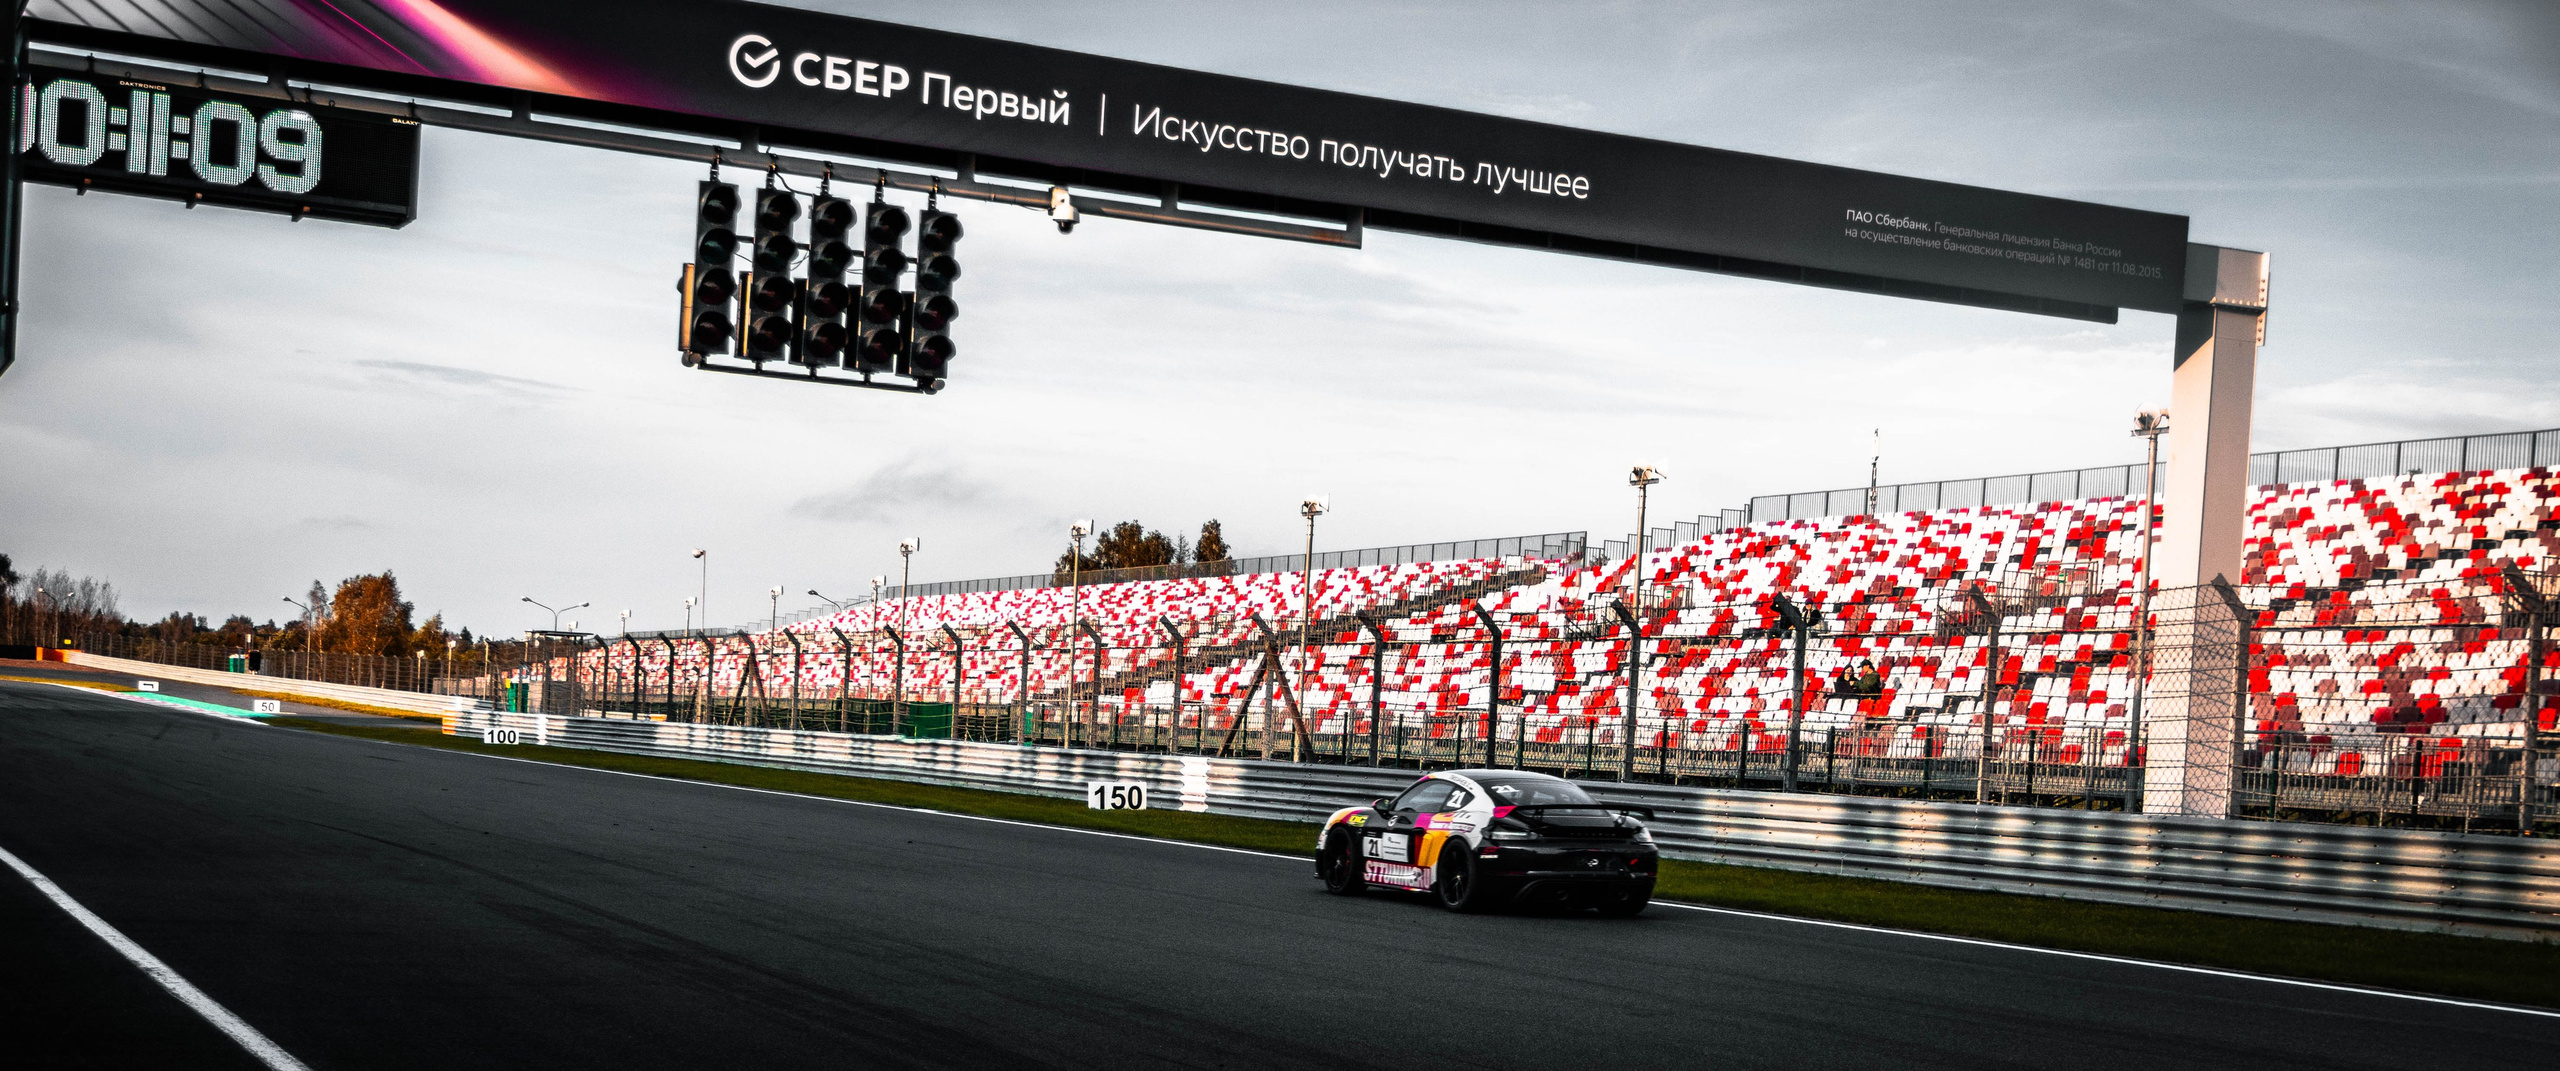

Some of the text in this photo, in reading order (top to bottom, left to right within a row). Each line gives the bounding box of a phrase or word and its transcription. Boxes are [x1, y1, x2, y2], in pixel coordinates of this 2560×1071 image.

[119, 79, 166, 91] DAKTRONICS
[792, 51, 1071, 126] СБЕР Первый
[391, 116, 420, 126] GALAXY
[1133, 103, 1590, 200] Искусство получать лучшее
[1846, 209, 2121, 258] ПАО Сбербанк. Генеральная лицензия Банка России
[1845, 228, 1858, 238] на
[1860, 230, 1941, 249] осуществление
[1943, 239, 2003, 257] банковских
[2005, 250, 2055, 264] операций
[2058, 254, 2071, 266] №
[2074, 257, 2096, 269] 1481
[2098, 262, 2109, 271] от
[261, 702, 275, 712] 50
[488, 729, 517, 744] 100
[1094, 785, 1143, 810] 150
[1446, 790, 1466, 809] 21
[1368, 838, 1380, 857] 21
